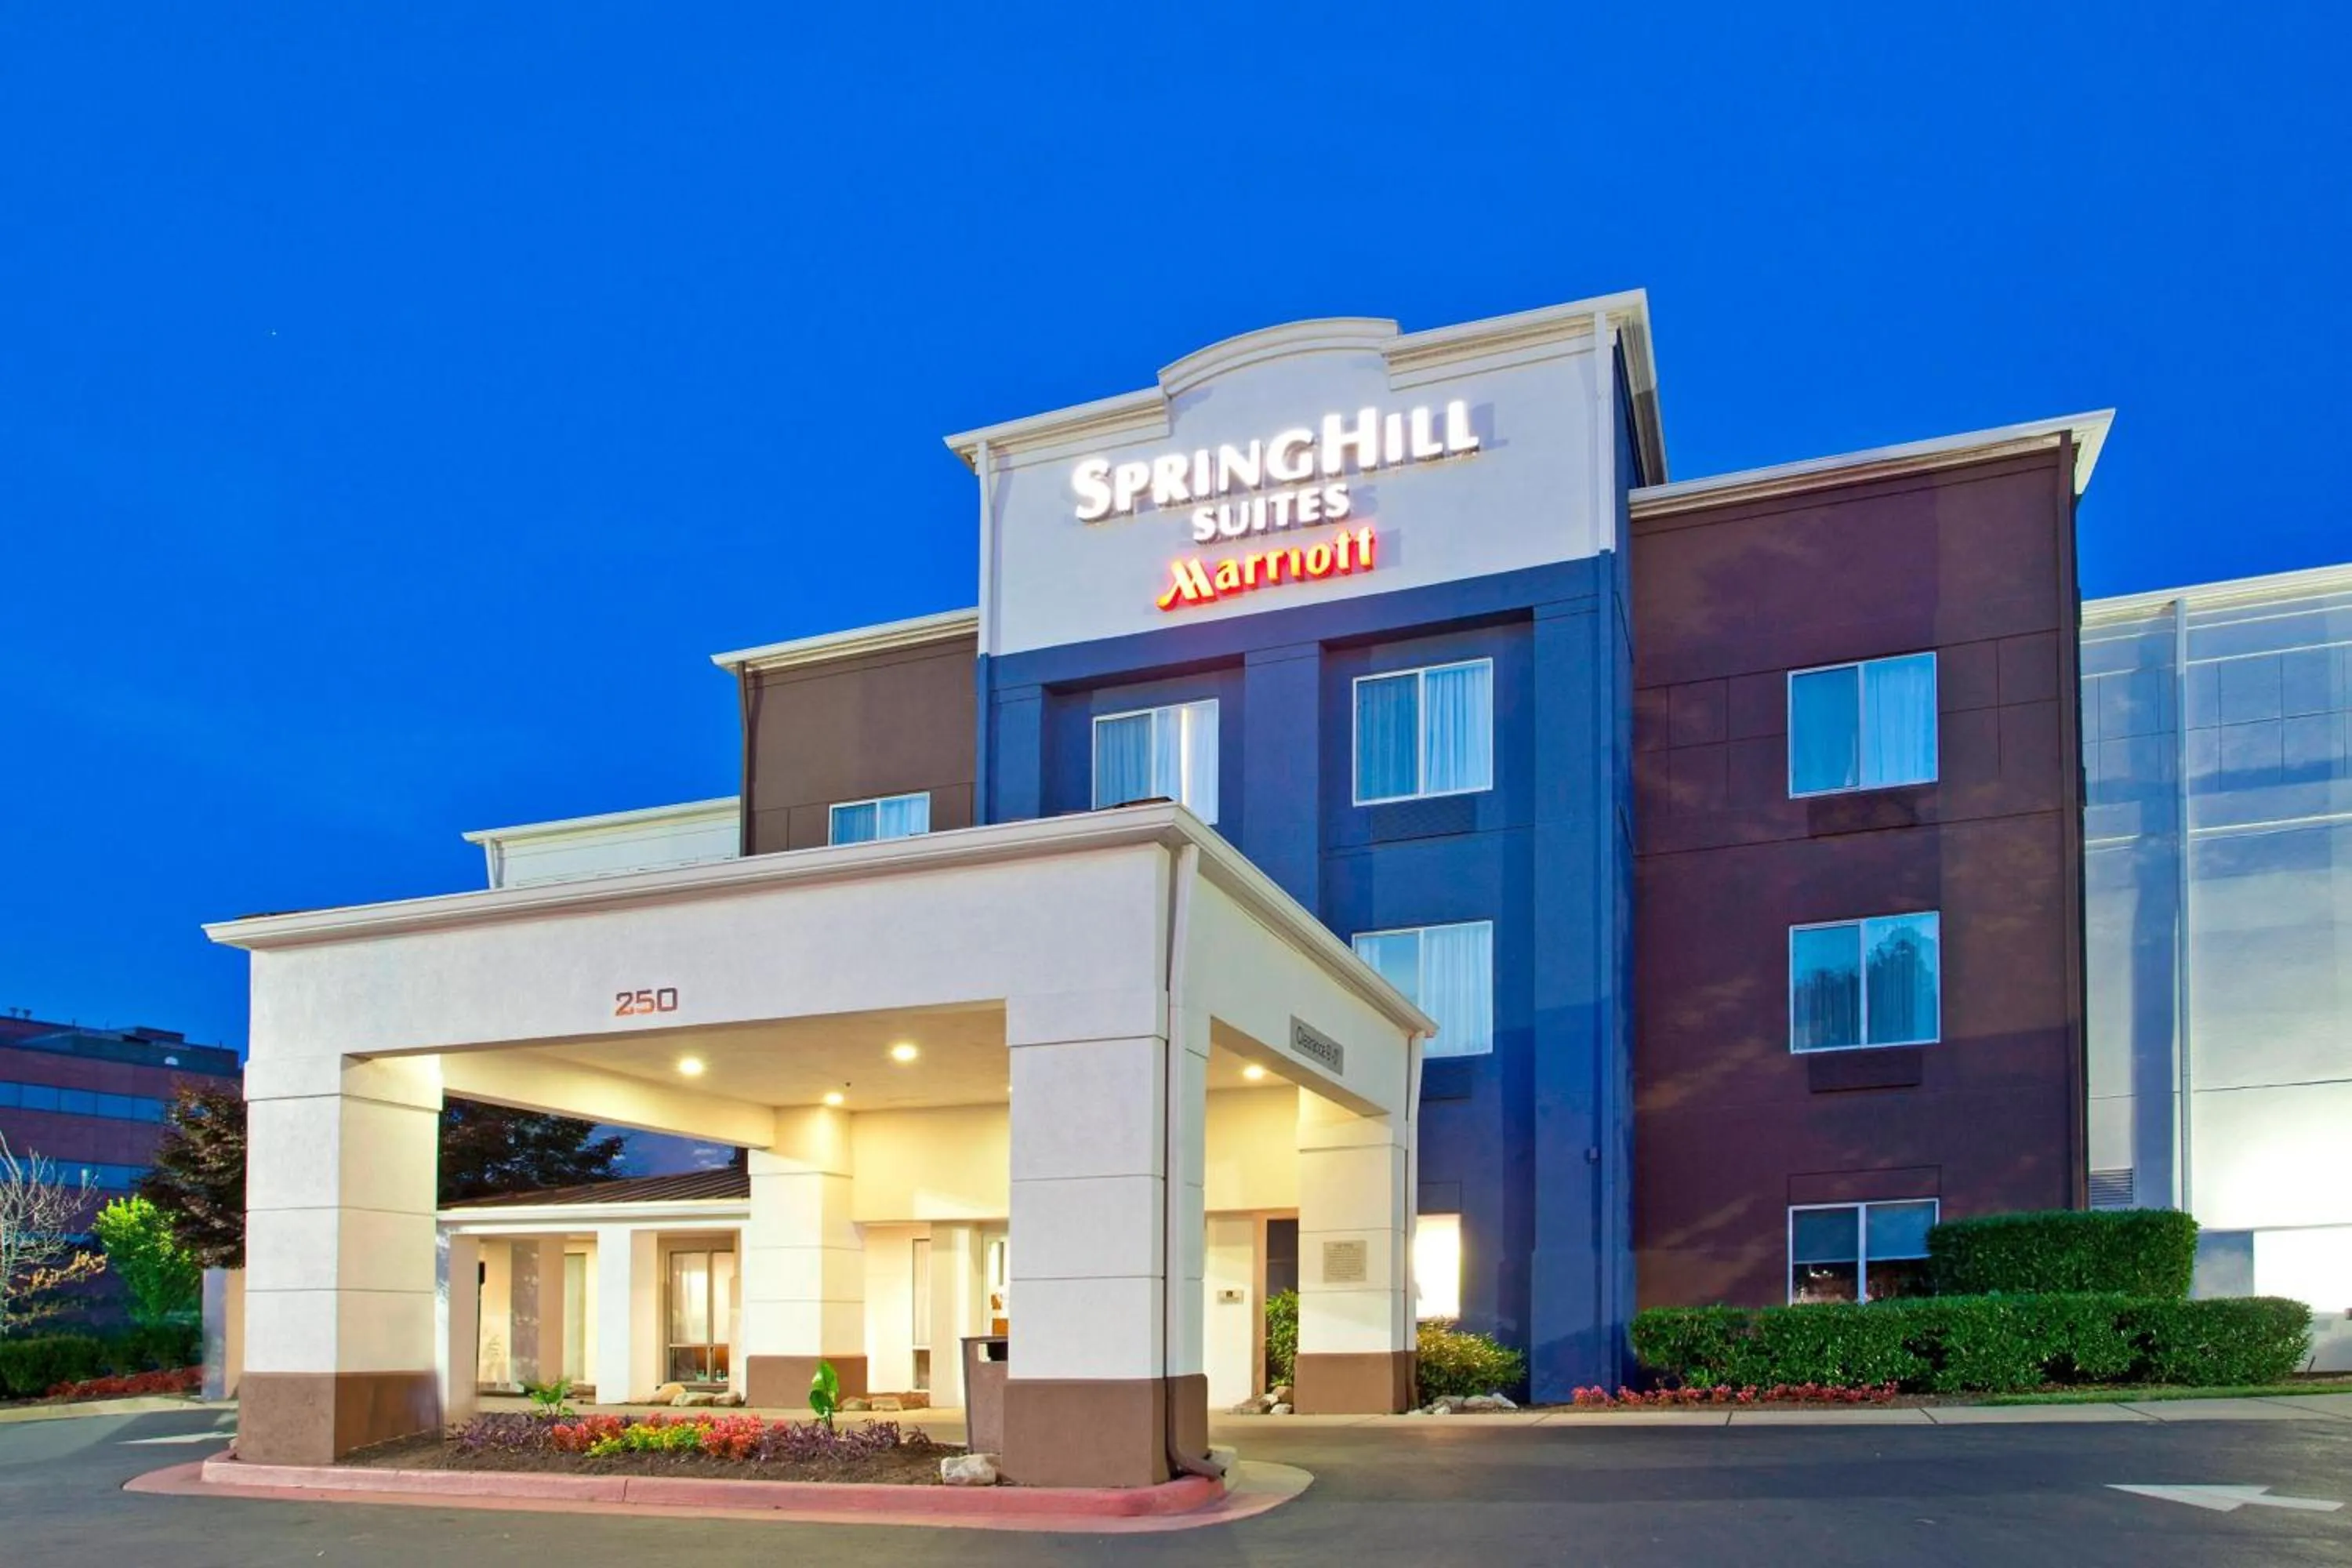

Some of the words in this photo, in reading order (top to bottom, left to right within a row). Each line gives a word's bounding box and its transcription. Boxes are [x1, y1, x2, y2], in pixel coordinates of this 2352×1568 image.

[1192, 483, 1352, 545] SUITES
[1156, 525, 1375, 612] Marriott
[615, 987, 678, 1017] 250
